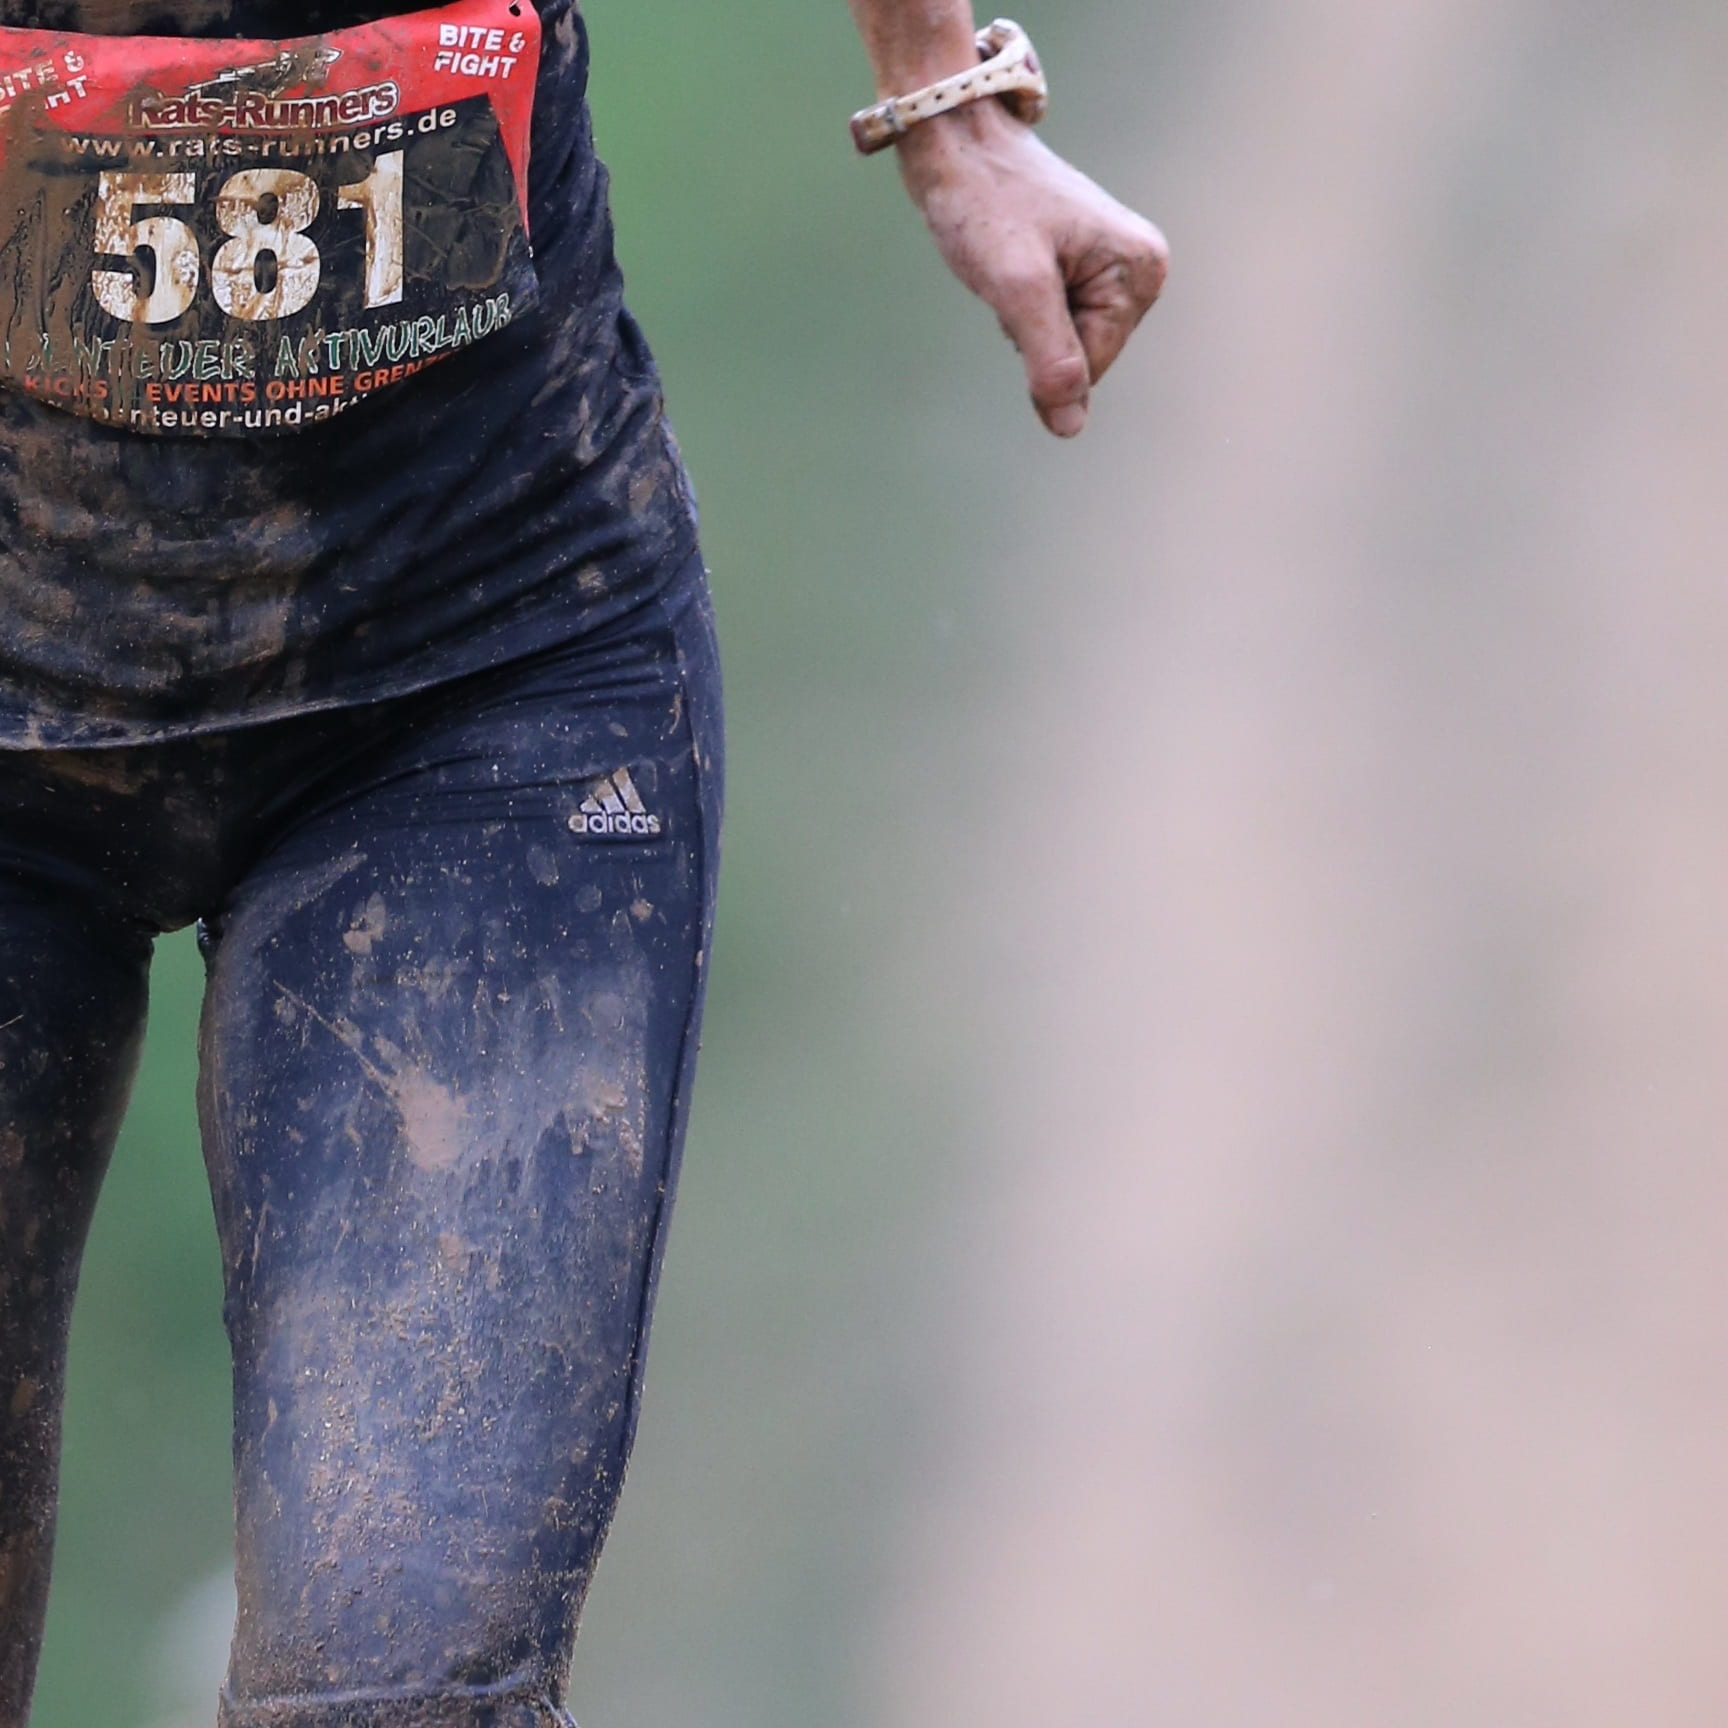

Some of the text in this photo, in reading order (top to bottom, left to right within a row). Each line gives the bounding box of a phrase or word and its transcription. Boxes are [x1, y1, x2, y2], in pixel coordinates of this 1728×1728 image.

[438, 23, 526, 53] BITE &
[63, 50, 85, 73] &
[433, 50, 518, 80] FIGHT
[126, 80, 400, 130] Rats-Runners
[91, 148, 405, 326] 581
[4, 292, 512, 381] NTEUER AKTIVURLAUB
[146, 381, 257, 404] EVENTS
[264, 375, 345, 403] OHNE
[353, 352, 452, 392] GREN
[567, 810, 662, 835] adidas
